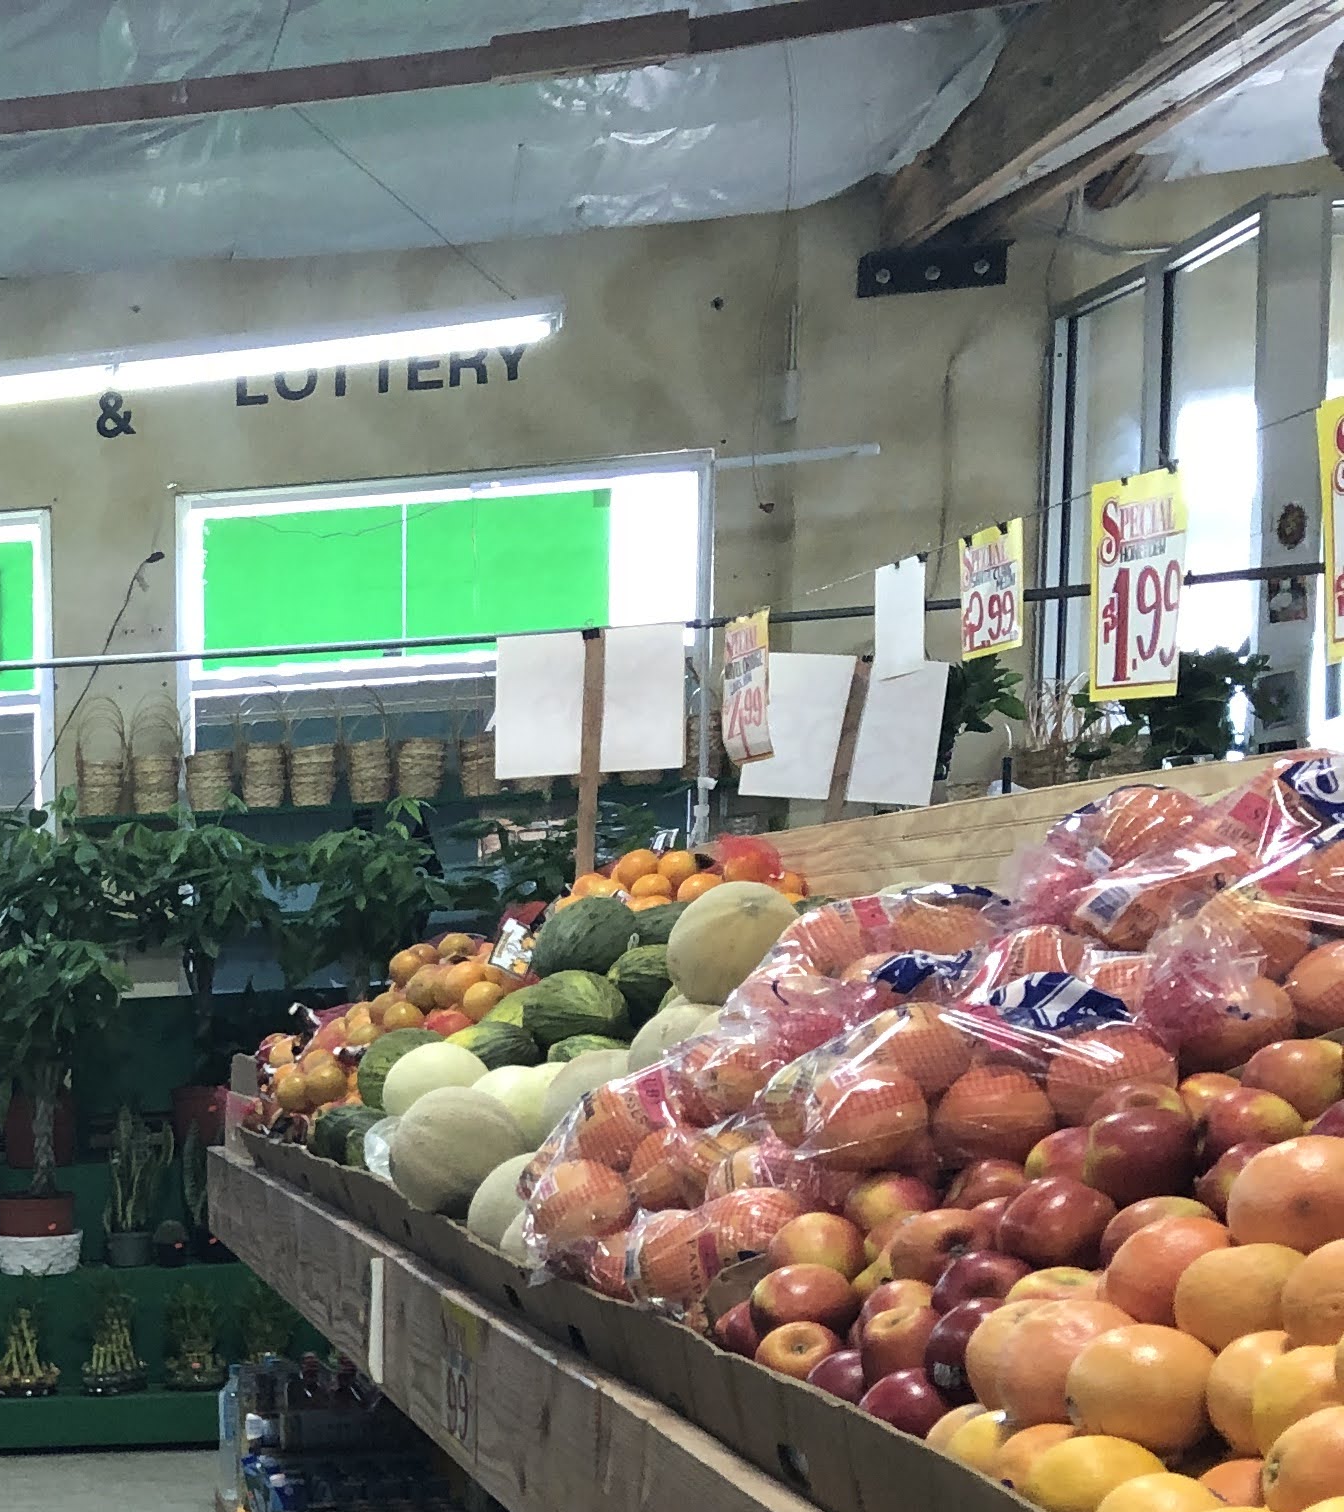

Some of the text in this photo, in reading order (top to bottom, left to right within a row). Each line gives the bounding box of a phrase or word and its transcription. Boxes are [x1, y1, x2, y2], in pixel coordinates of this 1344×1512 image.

[235, 345, 529, 406] LOTTERY
[97, 393, 135, 439] &
[1101, 498, 1175, 565] SPECIAL
[1103, 560, 1181, 681] $1.99
